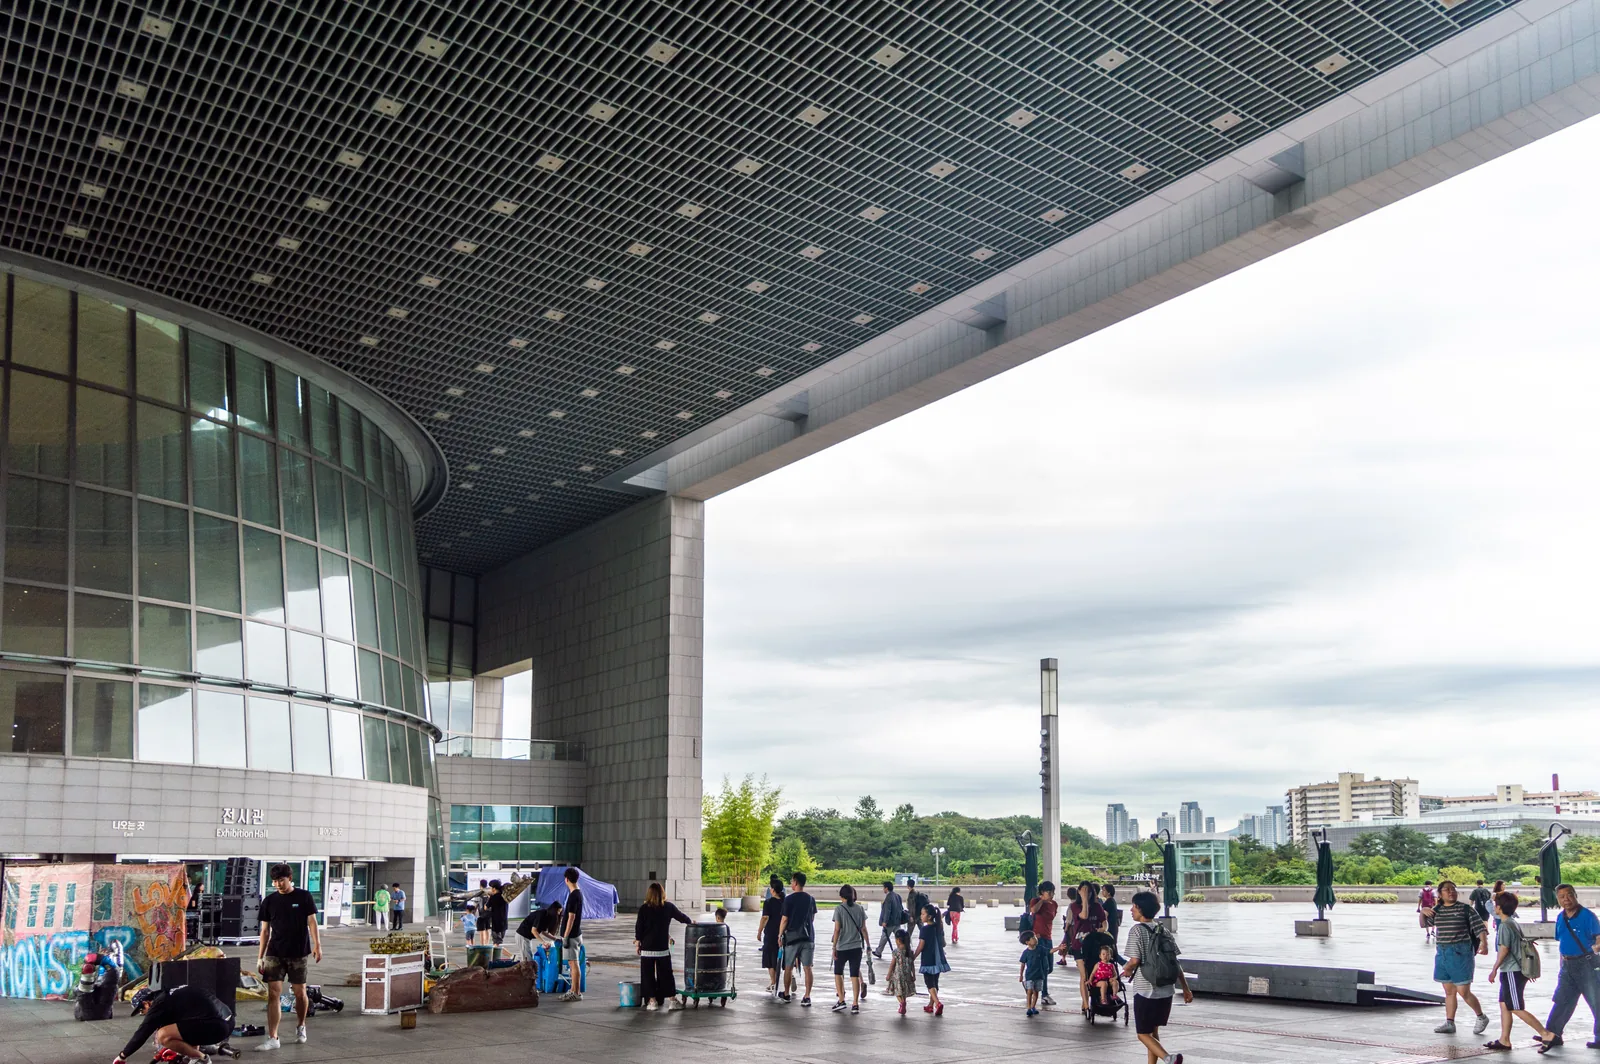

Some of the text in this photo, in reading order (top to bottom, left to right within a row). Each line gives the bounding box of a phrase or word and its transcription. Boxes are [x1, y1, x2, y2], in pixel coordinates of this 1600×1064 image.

[221, 808, 265, 825] 전시관
[112, 820, 145, 831] 나오는 곳
[215, 828, 269, 839] Exhibition Hall
[0, 926, 143, 999] MONSTR
